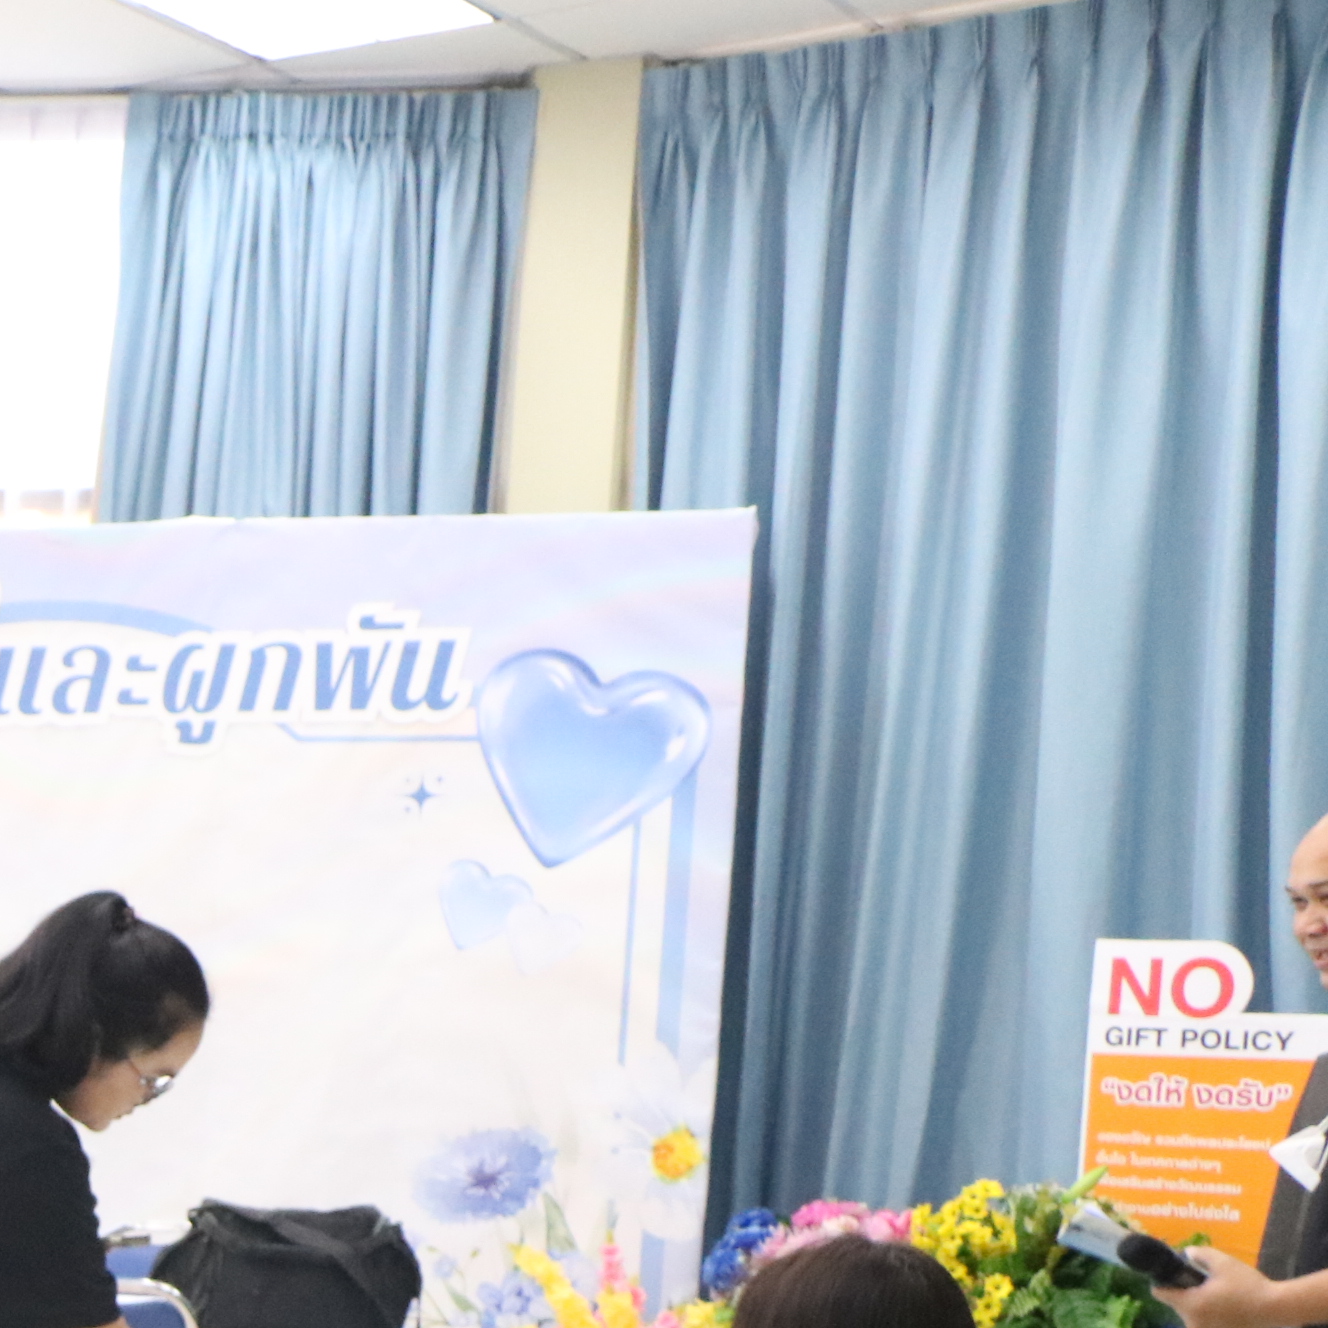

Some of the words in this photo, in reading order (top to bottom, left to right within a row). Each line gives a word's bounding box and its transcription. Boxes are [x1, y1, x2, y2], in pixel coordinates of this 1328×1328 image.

[1108, 957, 1235, 1017] NO
[1104, 1026, 1168, 1048] GIFT
[1181, 1029, 1296, 1052] POLICY
